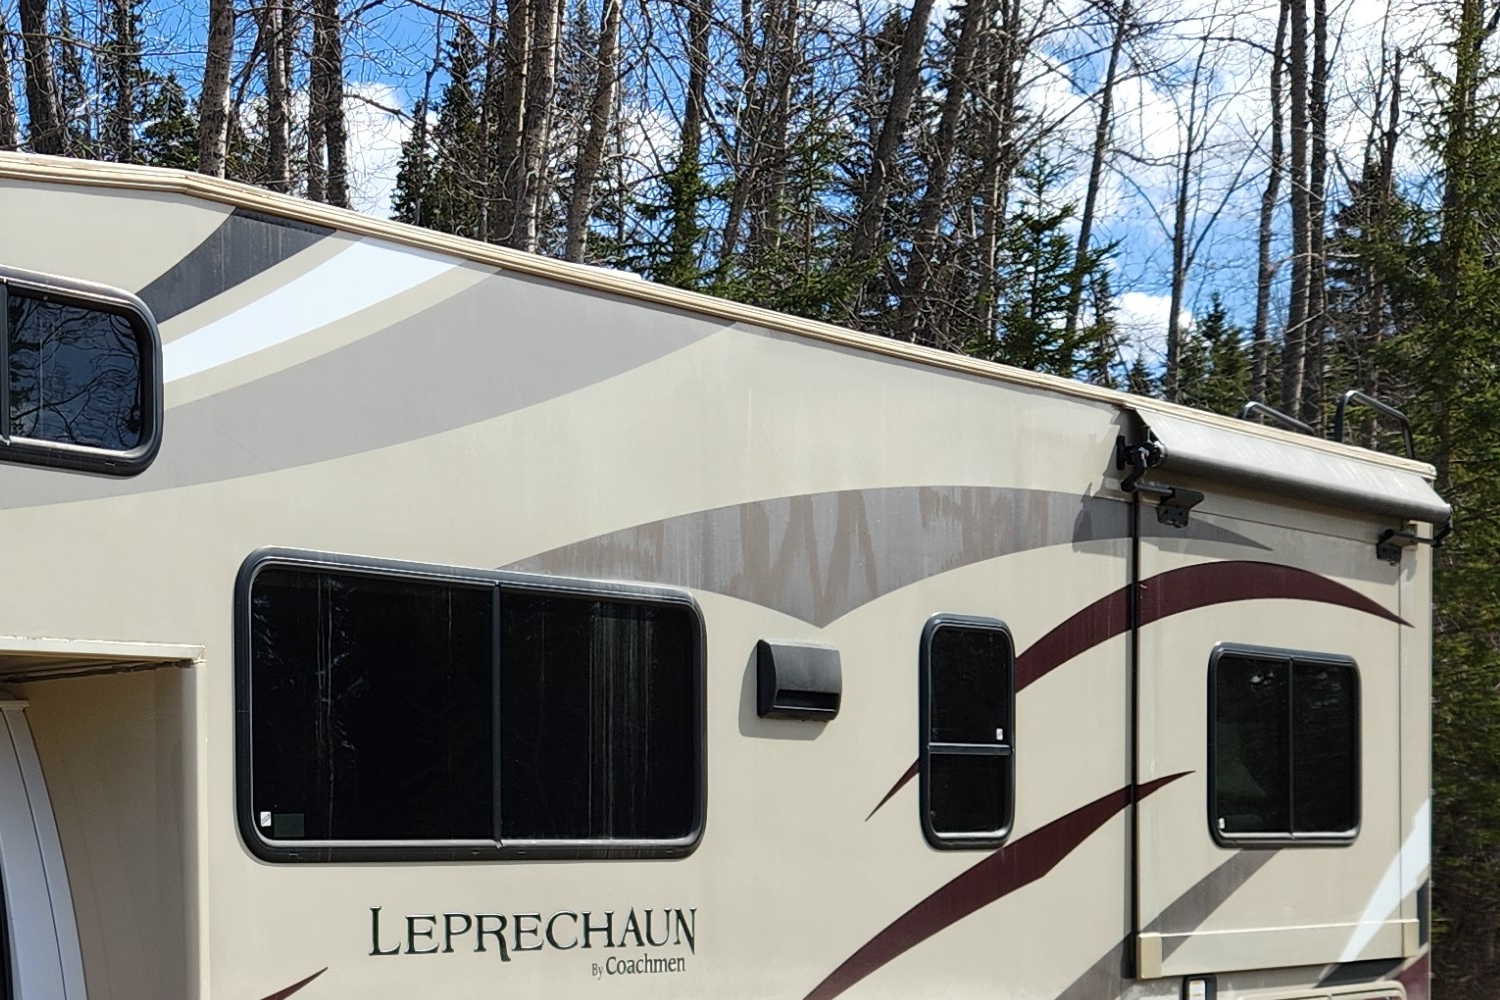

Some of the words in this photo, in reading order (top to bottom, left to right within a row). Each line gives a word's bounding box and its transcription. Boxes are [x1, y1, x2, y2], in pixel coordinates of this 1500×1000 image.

[368, 905, 697, 962] LEPRECHAUN
[591, 962, 604, 980] By
[606, 953, 685, 975] Coachmen
